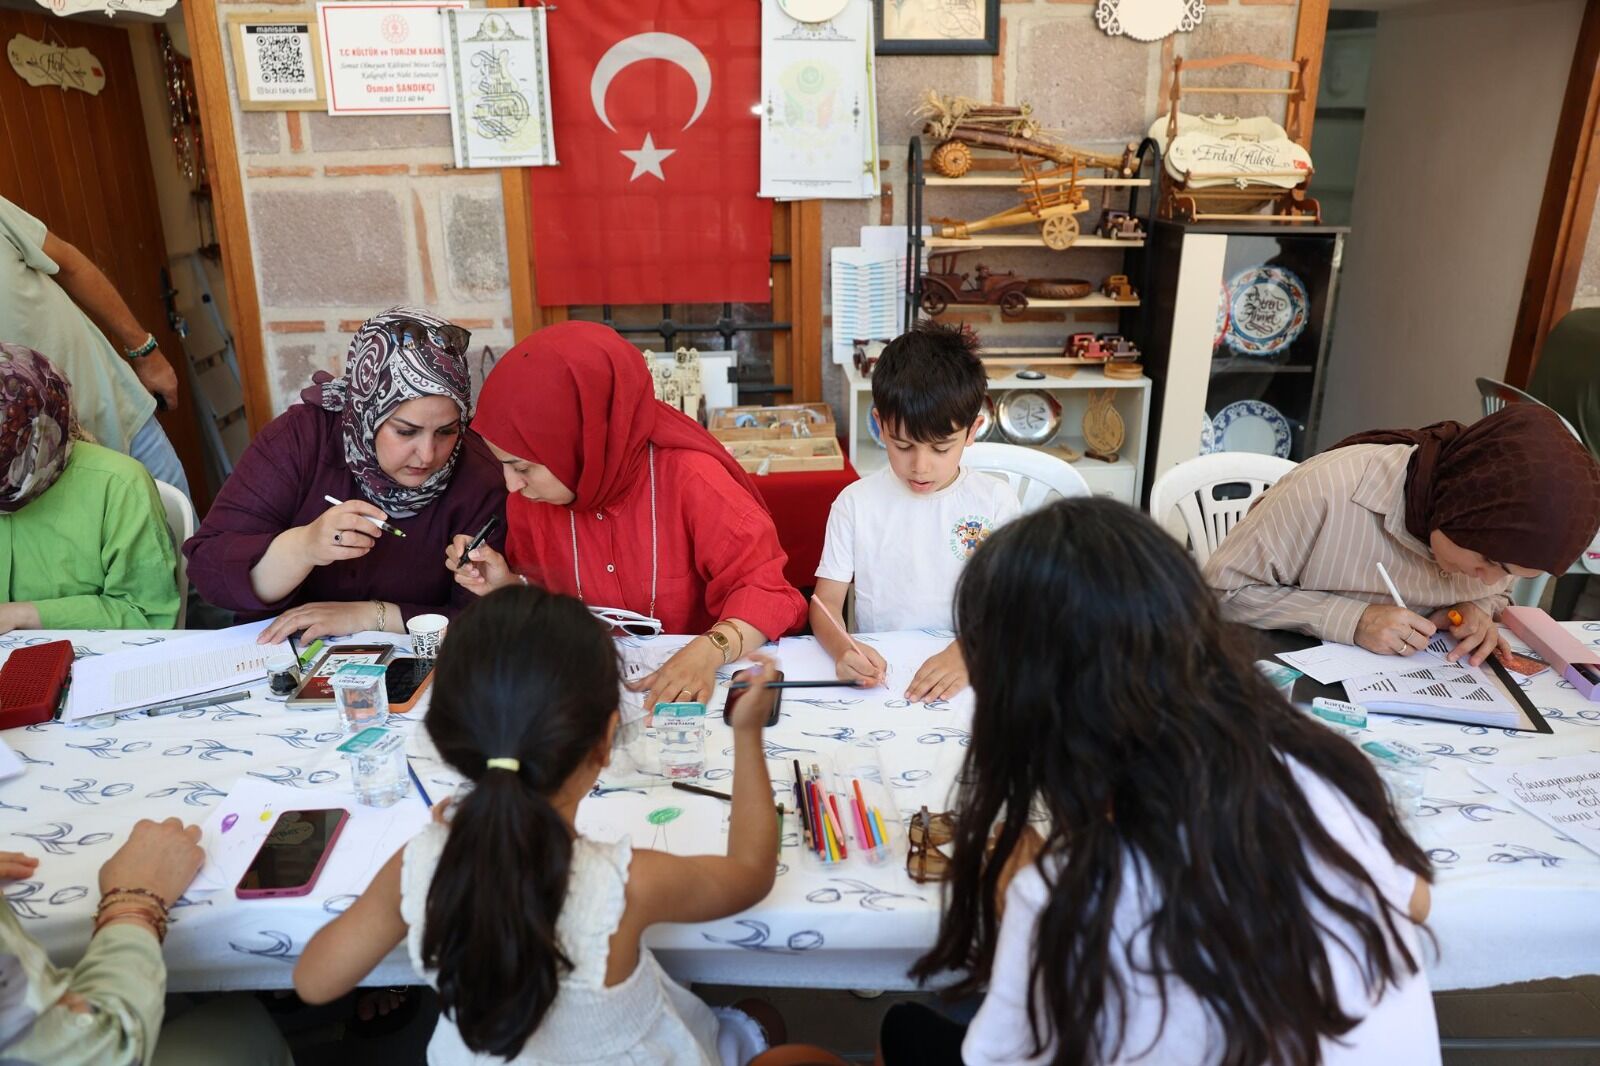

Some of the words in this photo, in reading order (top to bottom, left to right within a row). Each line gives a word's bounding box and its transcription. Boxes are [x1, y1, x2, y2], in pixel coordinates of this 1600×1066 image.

[366, 84, 394, 93] Osman
[396, 83, 435, 94] SANDIKÇI
[1199, 147, 1238, 162] Erdal
